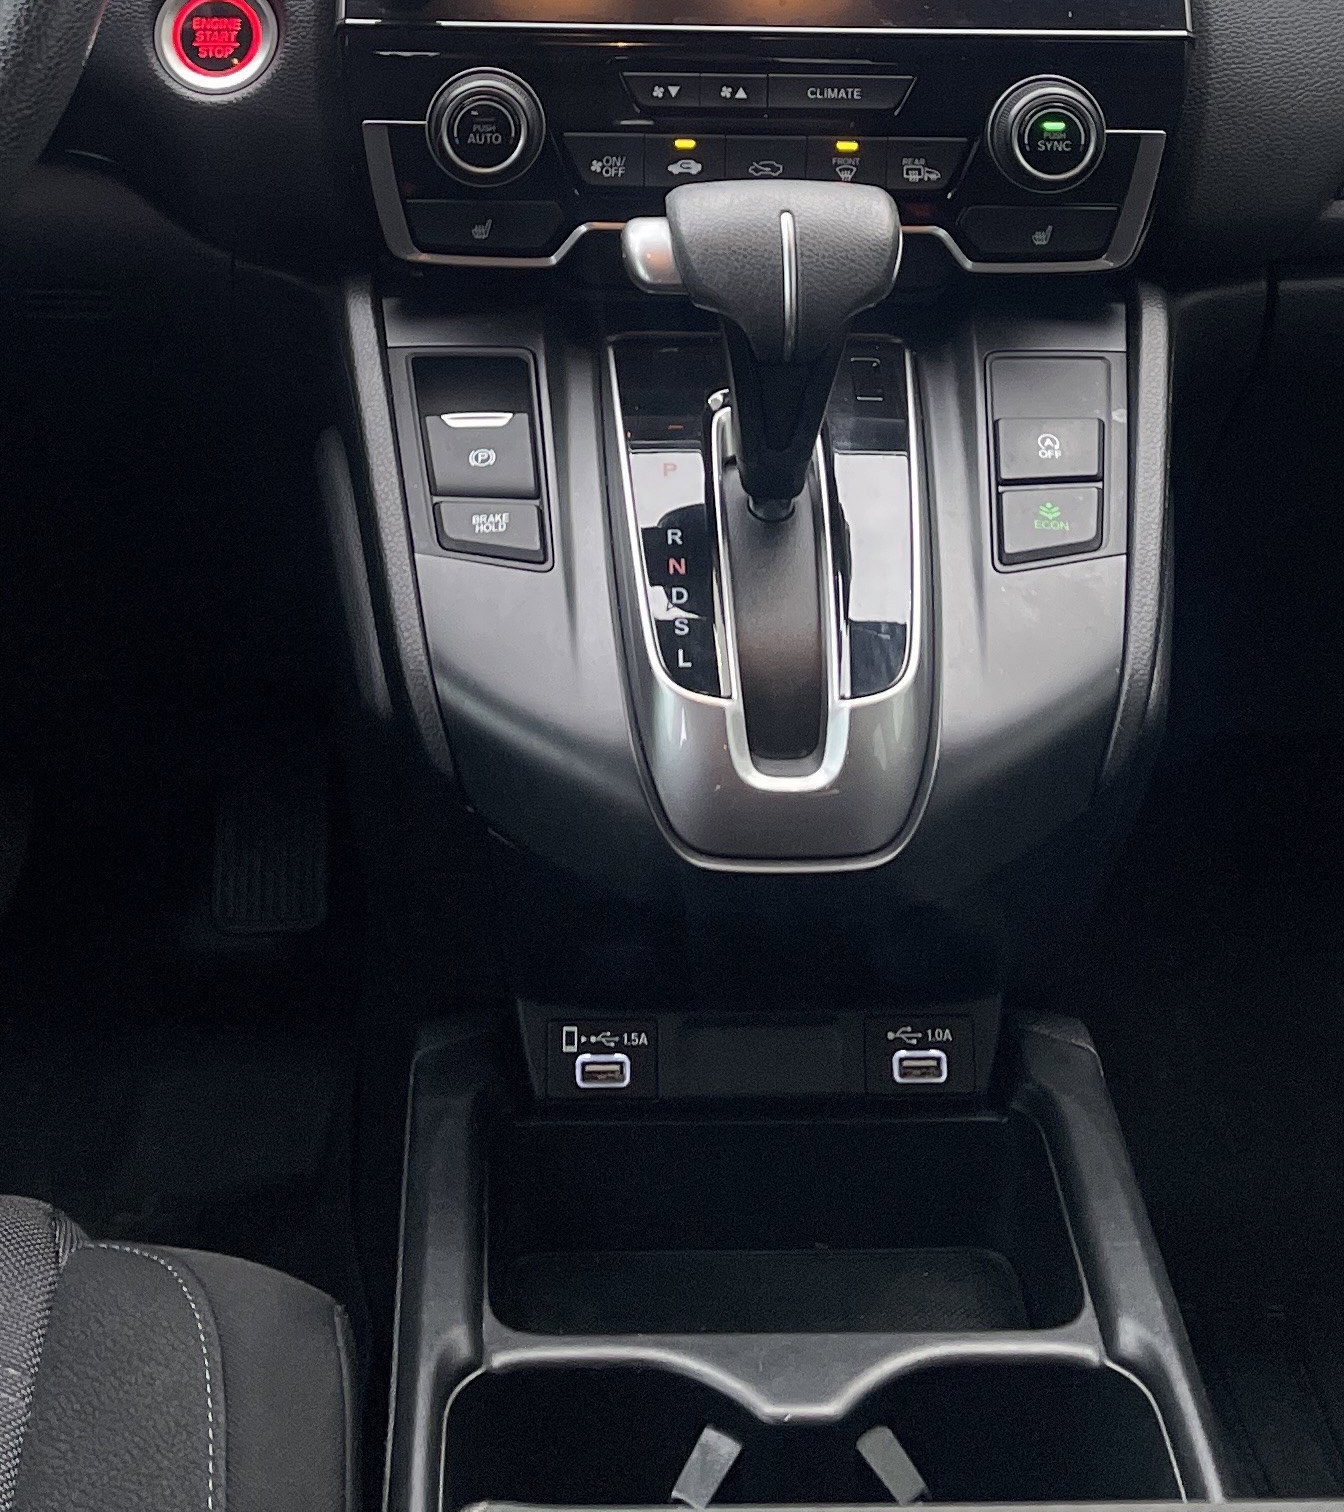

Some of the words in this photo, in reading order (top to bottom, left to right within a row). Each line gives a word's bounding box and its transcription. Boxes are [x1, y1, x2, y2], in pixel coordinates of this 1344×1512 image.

[192, 17, 242, 31] ENGINE
[195, 30, 239, 42] START
[197, 46, 234, 59] STOP
[807, 87, 862, 100] CLIMATE
[472, 123, 497, 133] PUSH
[467, 133, 502, 145] AUTO
[1037, 140, 1073, 152] SYNC
[602, 155, 627, 167] ON/
[832, 157, 860, 166] FRONT
[901, 157, 926, 166] REAR
[602, 166, 627, 178] OFF
[1038, 449, 1062, 459] OFF
[662, 462, 678, 477] P
[472, 512, 510, 525] BRAKE
[1033, 519, 1070, 531] ECON
[474, 521, 507, 534] HOLD
[667, 529, 683, 545] R
[668, 557, 686, 575] N
[671, 587, 689, 604] D
[674, 618, 690, 636] S
[677, 648, 692, 668] L
[622, 1032, 649, 1047] 1.5A
[926, 1028, 953, 1043] 1.0A
